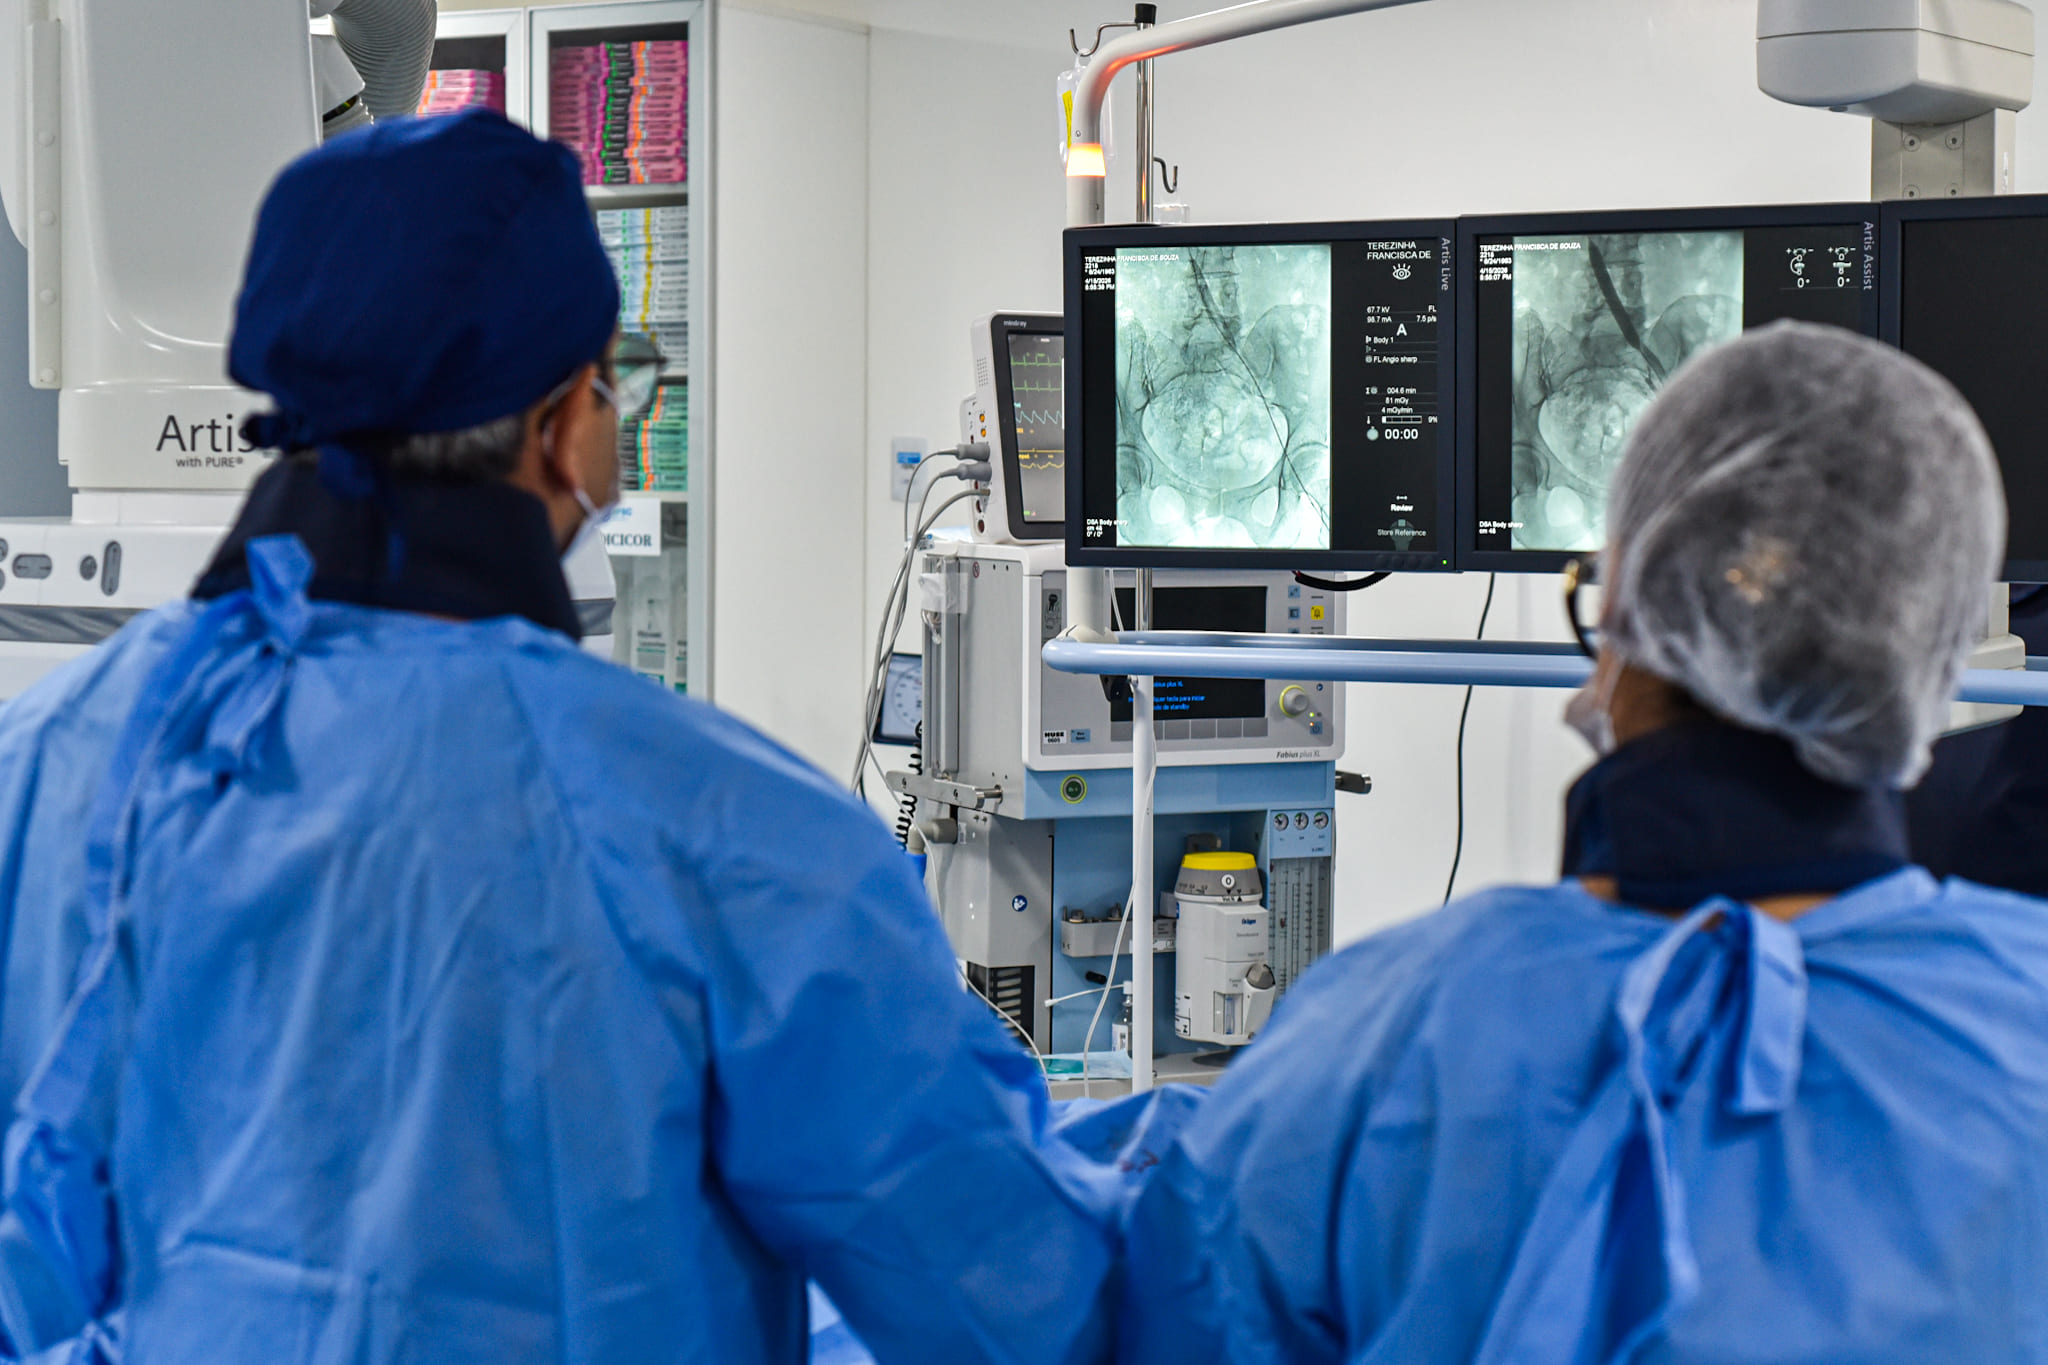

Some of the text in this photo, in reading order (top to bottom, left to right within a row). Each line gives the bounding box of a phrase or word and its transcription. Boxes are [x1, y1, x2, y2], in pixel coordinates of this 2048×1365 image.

[1368, 242, 1416, 250] TEREZINHA
[1864, 222, 1874, 290] Artis Assist
[1441, 238, 1451, 291] Artis Live
[1396, 324, 1408, 336] A
[1385, 428, 1418, 440] 00:00
[176, 457, 202, 468] with
[1492, 521, 1506, 529] Body
[1276, 750, 1298, 758] Fabius
[1226, 876, 1232, 885] 0
